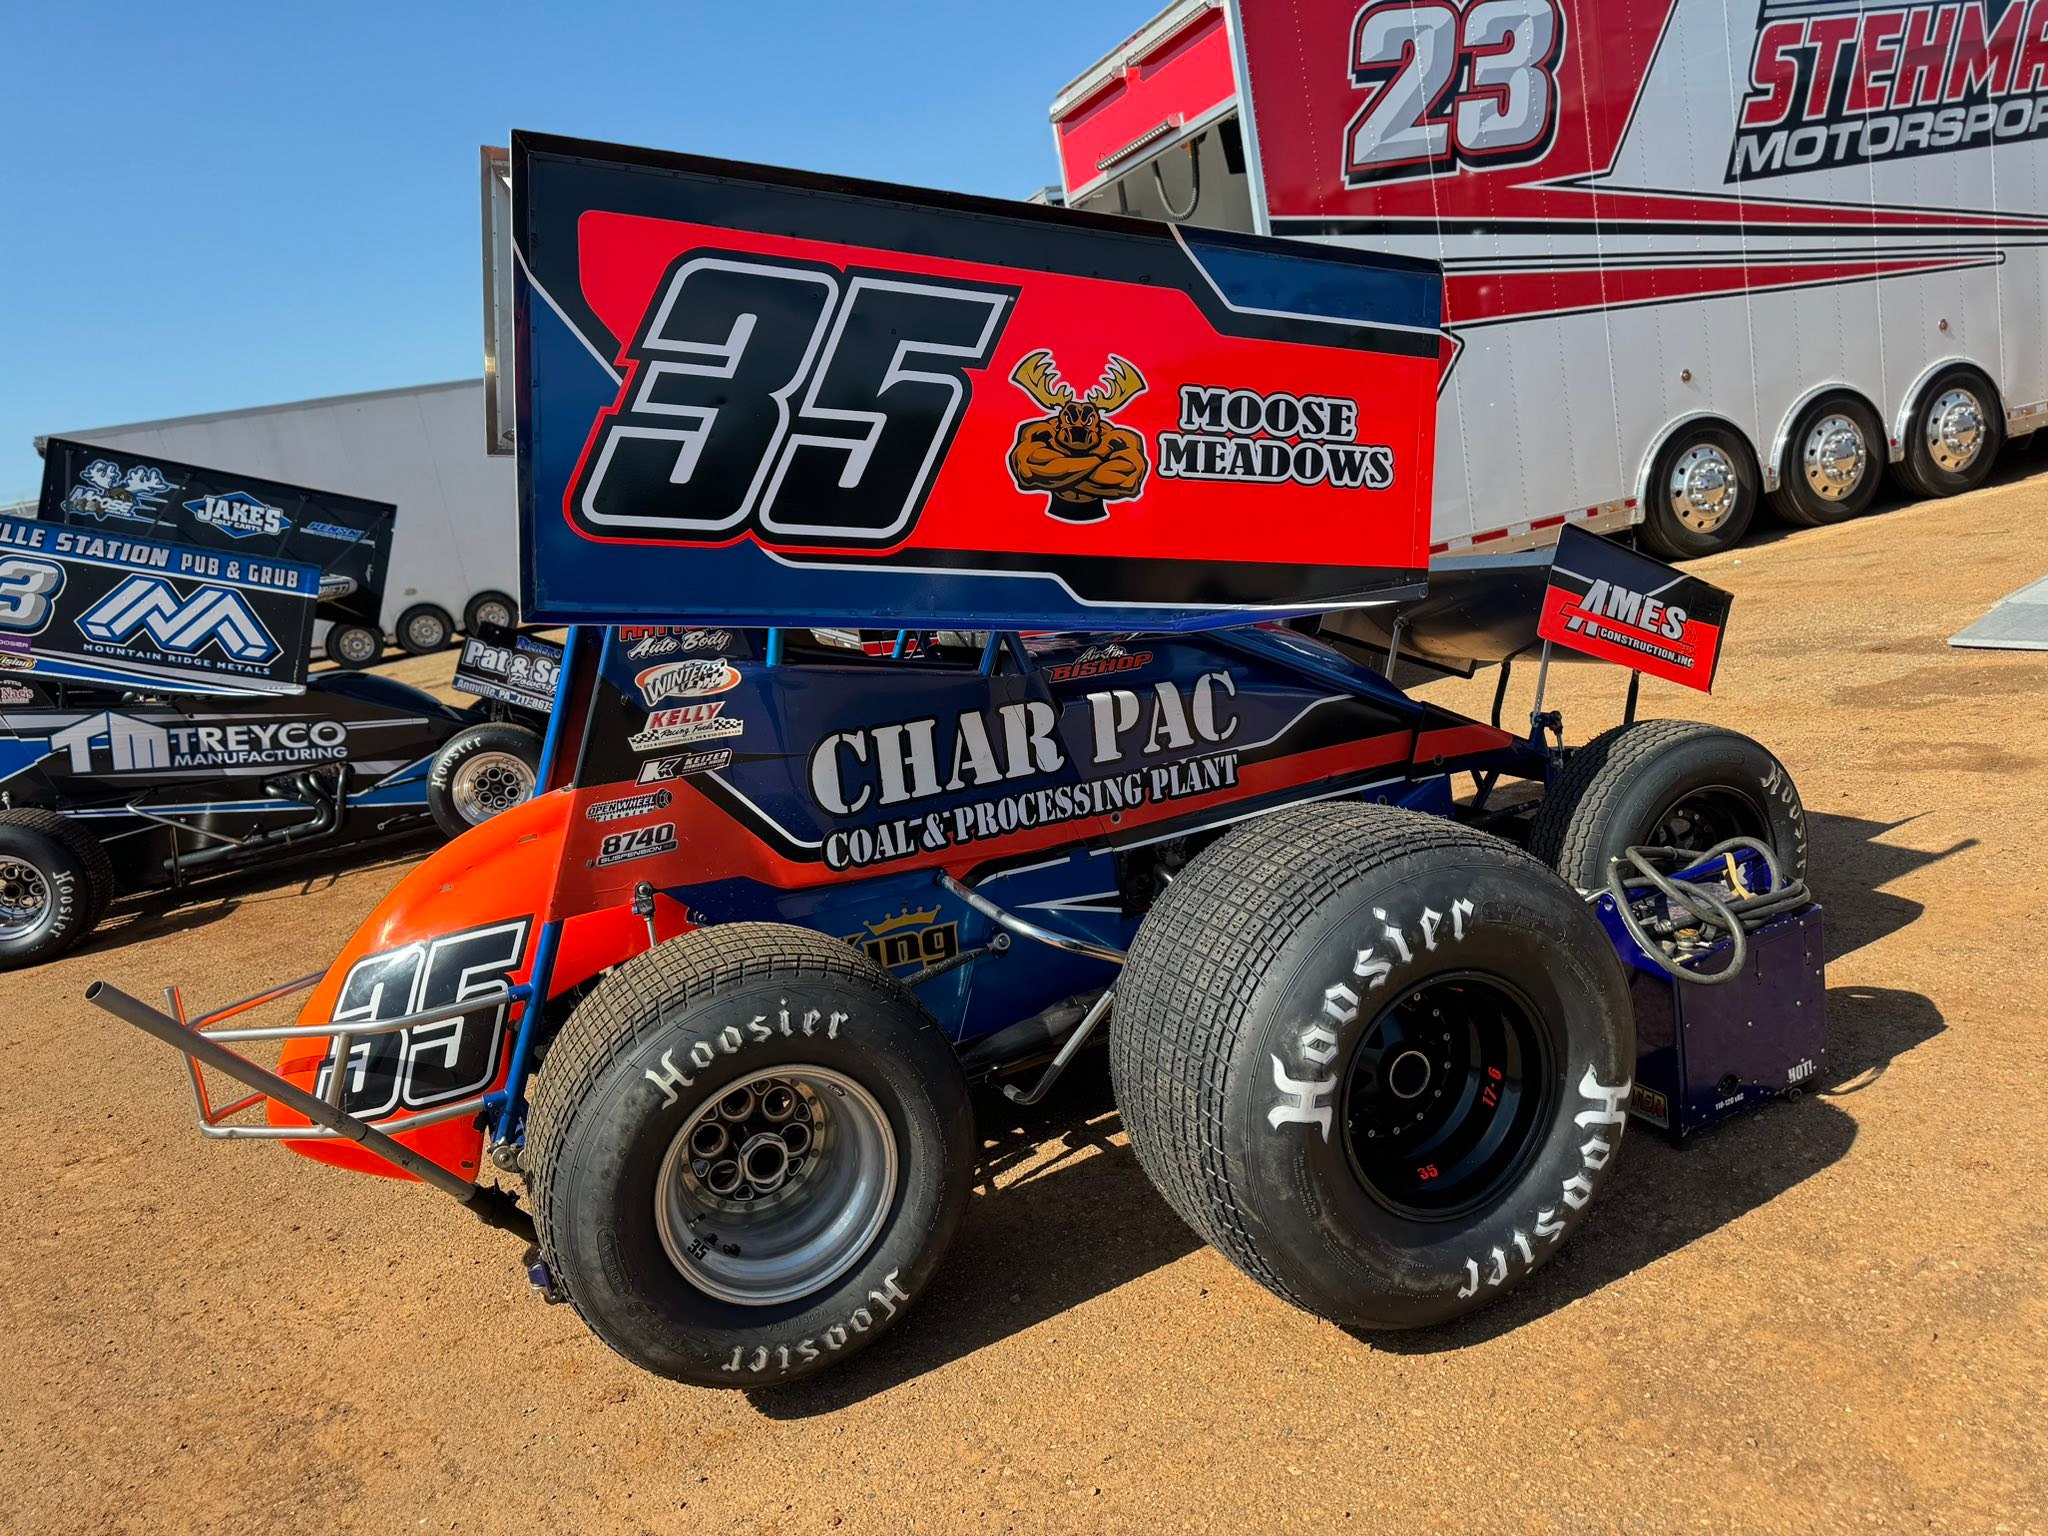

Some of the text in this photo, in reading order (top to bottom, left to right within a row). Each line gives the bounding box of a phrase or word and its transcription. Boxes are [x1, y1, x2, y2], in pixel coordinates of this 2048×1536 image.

[1347, 0, 1560, 180] 23
[578, 254, 1013, 542] 35
[1180, 385, 1358, 442] MOOSE
[1158, 436, 1394, 488] MEADOWS
[198, 496, 282, 533] JAKE'S
[212, 518, 262, 532] GOLF CARTS
[0, 522, 298, 588] LLE STATION PUB & GRUB
[0, 556, 64, 633] 3
[1563, 578, 1688, 640] AMES
[83, 644, 271, 676] MOUNTAIN RIDGE METALS
[464, 639, 510, 674] Pat
[510, 656, 529, 678] &
[629, 631, 679, 658] Auto
[683, 630, 731, 650] Body
[644, 662, 722, 704] WINTERS
[1052, 652, 1152, 681] BISHOP
[498, 689, 511, 701] PA
[649, 703, 722, 729] KELLY
[660, 726, 690, 738] Racing
[170, 721, 347, 754] TREYCO
[174, 746, 348, 767] MANUFACTURING
[811, 670, 1238, 814] CHAR PAC
[431, 736, 481, 791] Hoosier
[684, 750, 729, 765] KEIZER
[826, 754, 1239, 868] COAL & PROCESSING PLANT
[600, 846, 662, 864] SUSPENSION
[602, 823, 674, 855] 8740
[50, 869, 75, 938] Hoosier
[311, 918, 530, 1121] 35
[1267, 897, 1475, 1144] Hoosier
[645, 997, 849, 1110] Hoosier
[1788, 1059, 1813, 1084] HOT!
[1417, 1163, 1439, 1181] 35
[1458, 1063, 1632, 1299] Hoosier
[686, 1238, 711, 1262] 35
